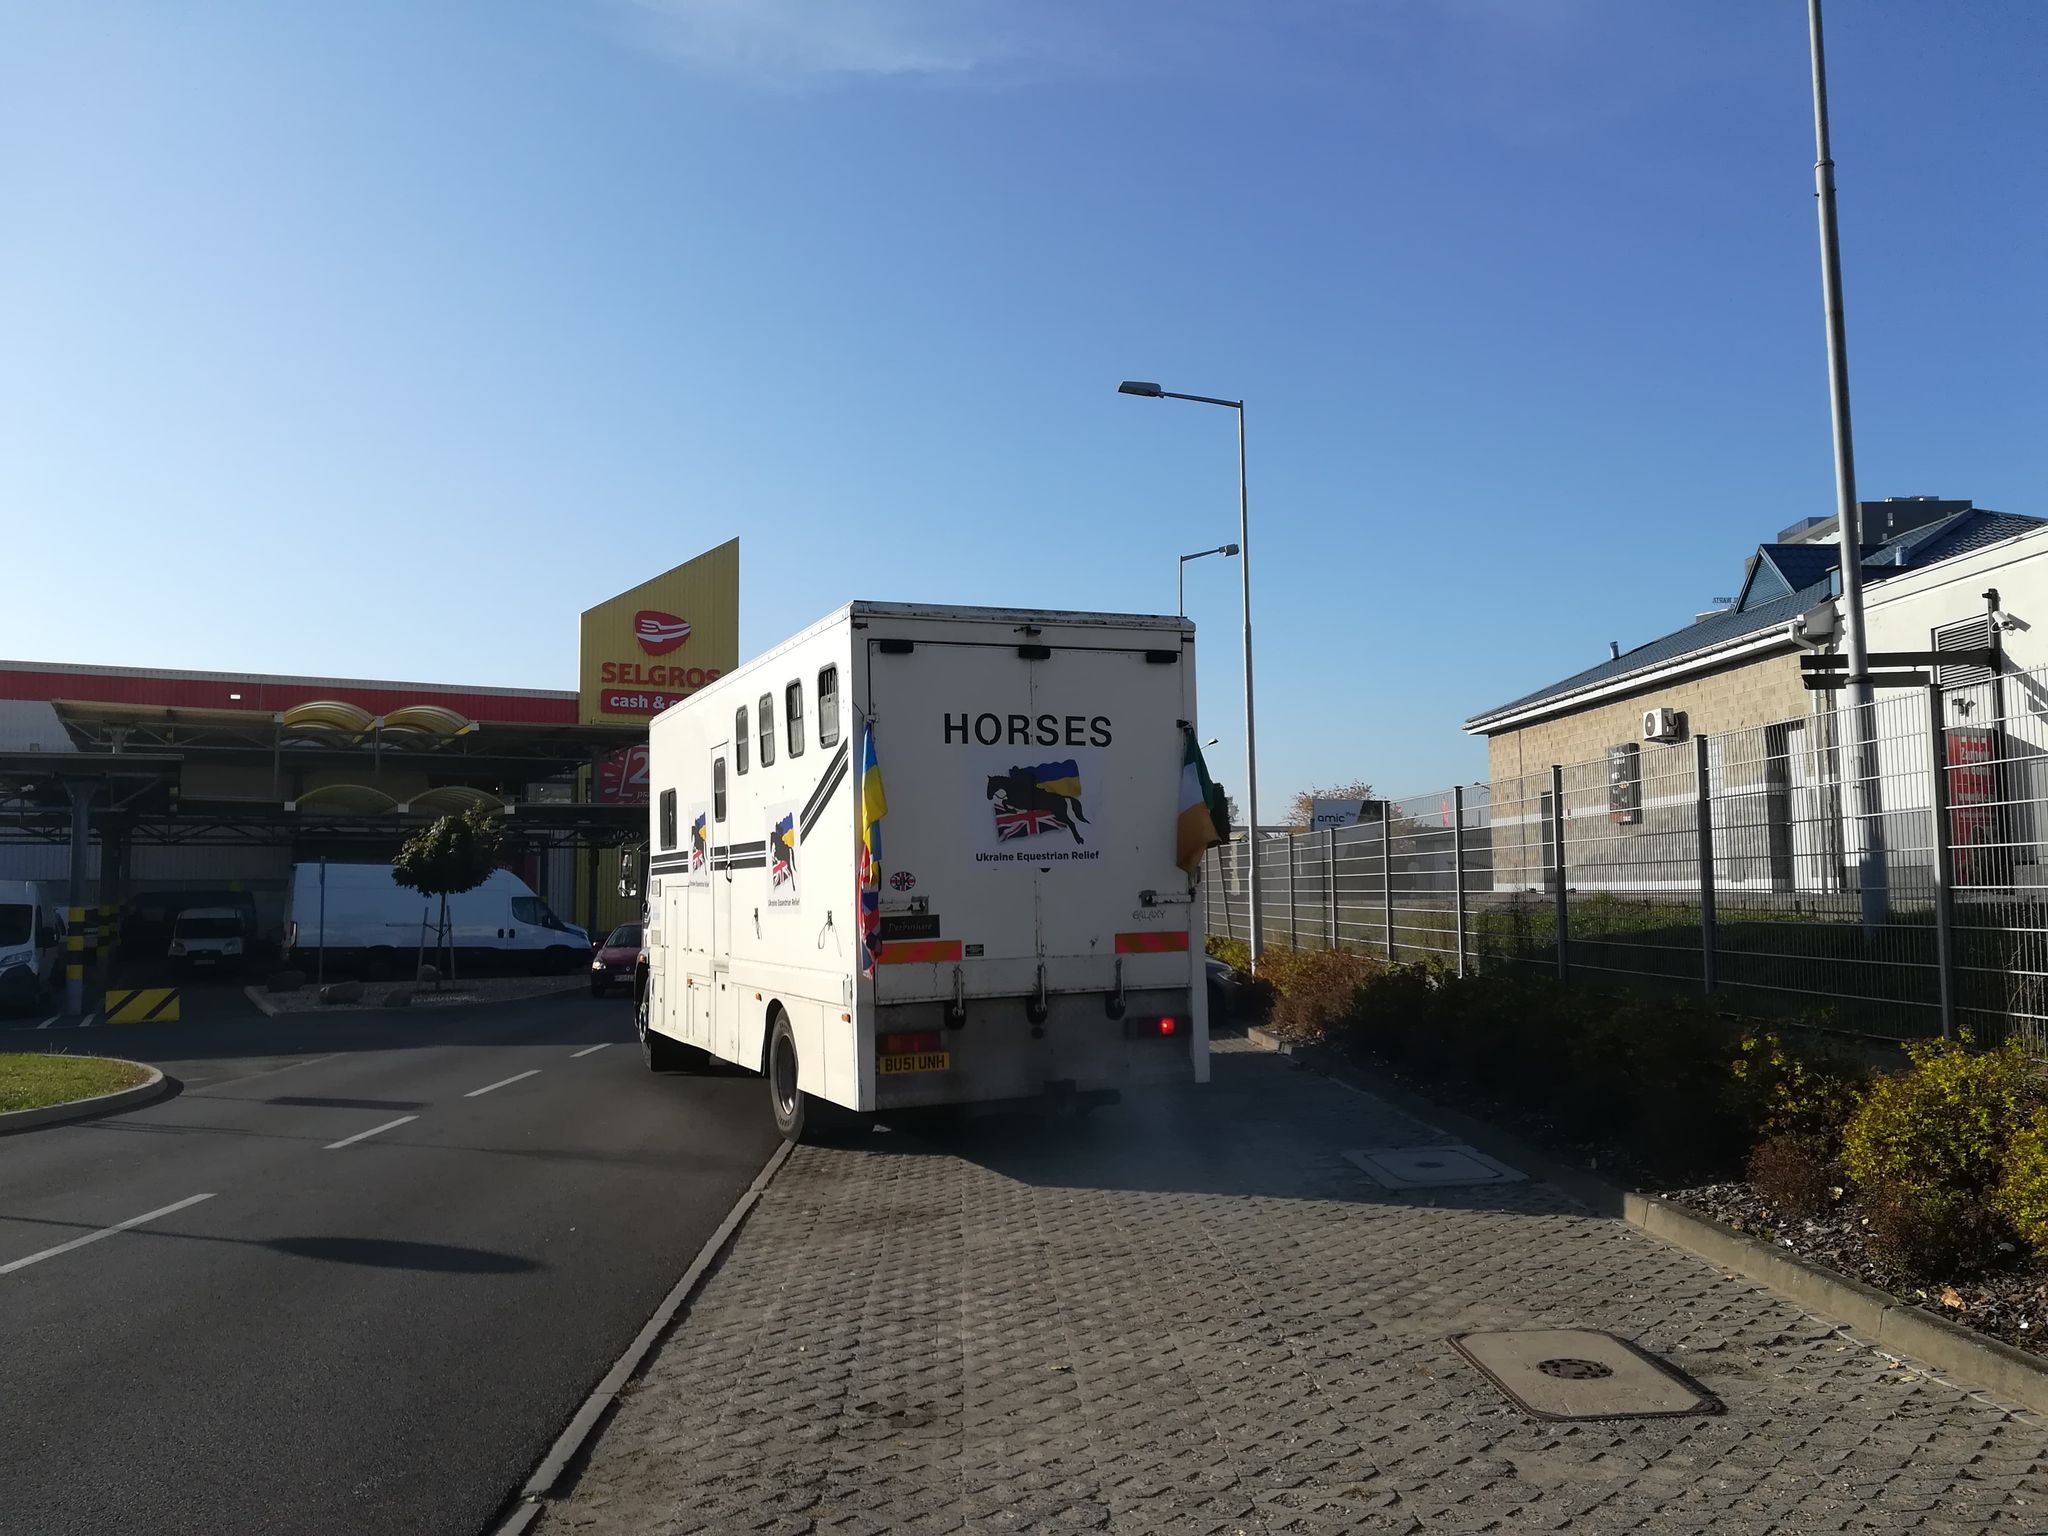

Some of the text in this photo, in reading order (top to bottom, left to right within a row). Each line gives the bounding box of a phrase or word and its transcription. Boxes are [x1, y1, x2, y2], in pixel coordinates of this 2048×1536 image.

[610, 695, 648, 708] cash
[652, 696, 665, 709] &
[944, 713, 1112, 747] HORSES
[1317, 813, 1345, 822] amic
[976, 850, 1099, 863] Ukraine Equestrian Relief
[1132, 910, 1166, 922] GALAXY
[919, 1055, 945, 1069] UNH
